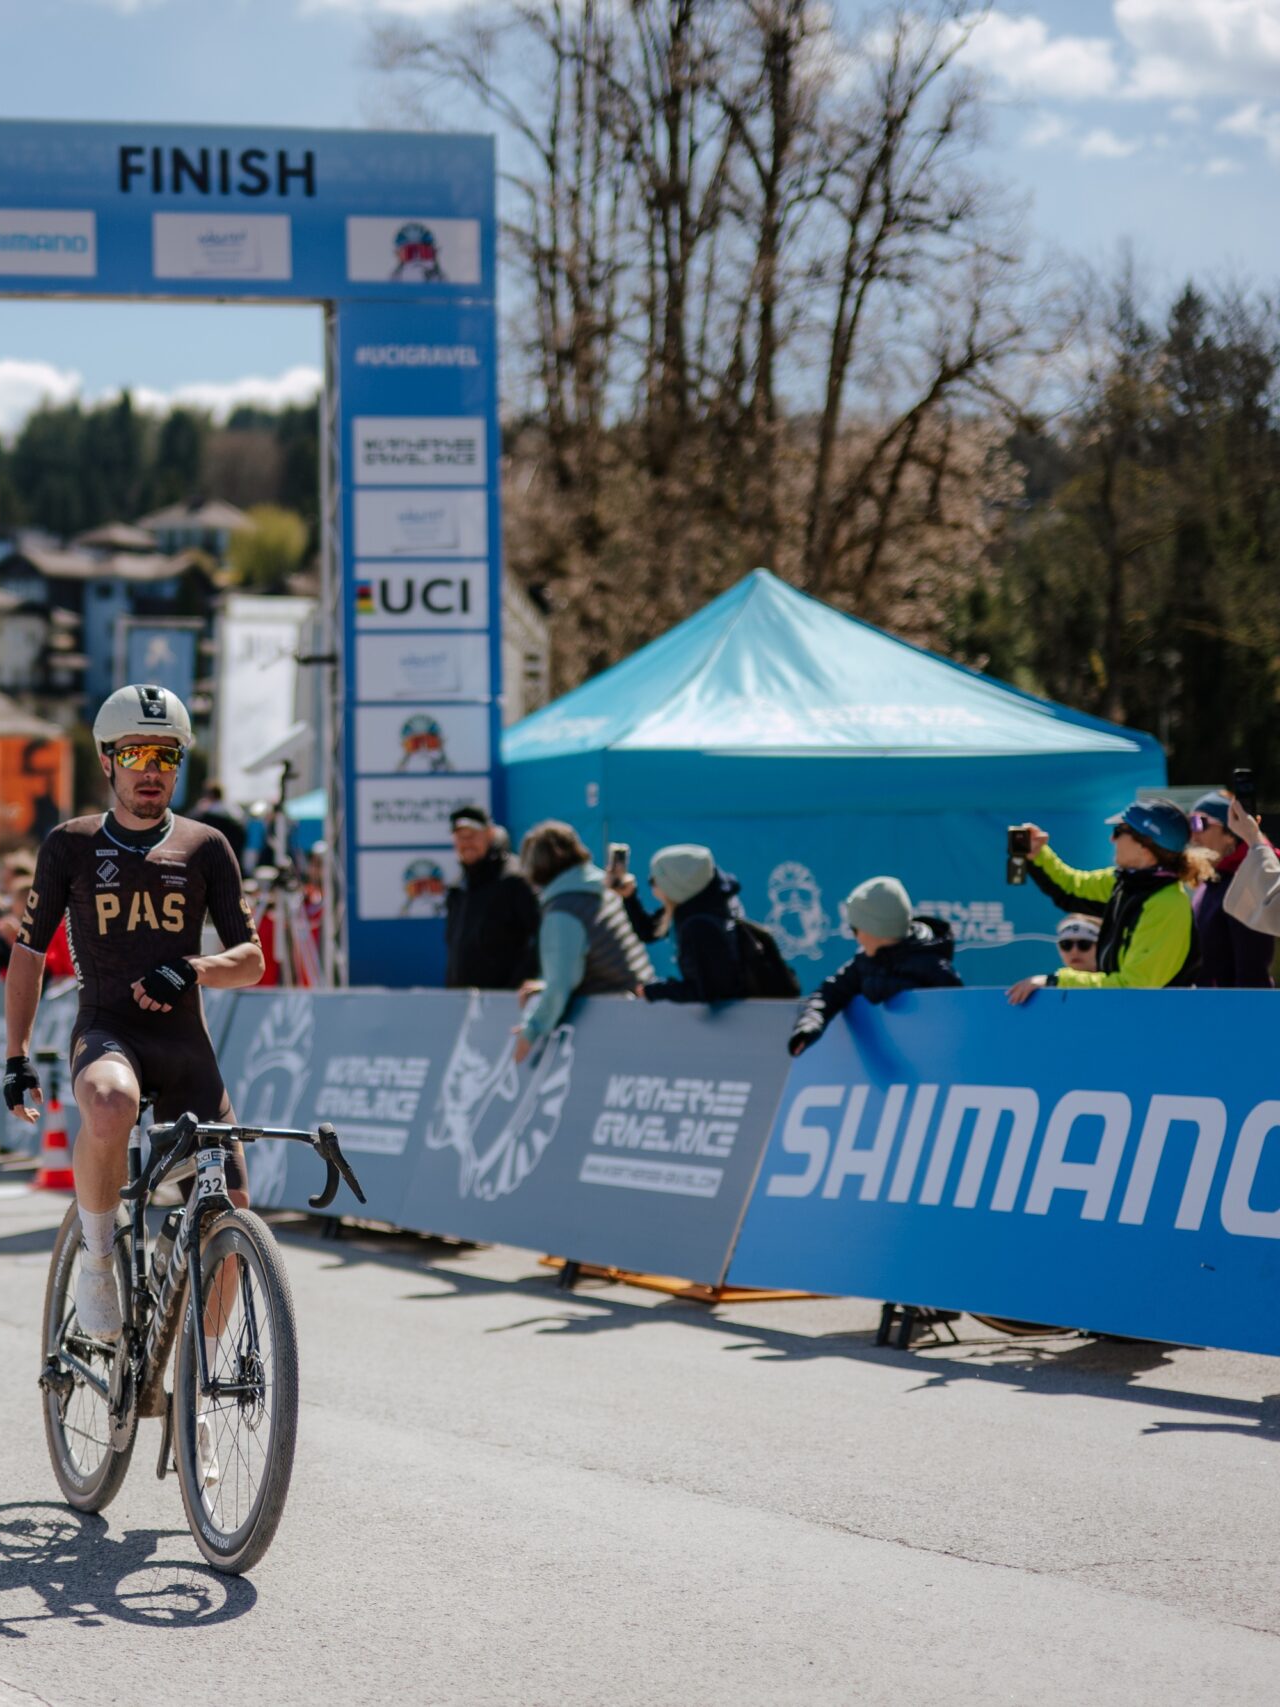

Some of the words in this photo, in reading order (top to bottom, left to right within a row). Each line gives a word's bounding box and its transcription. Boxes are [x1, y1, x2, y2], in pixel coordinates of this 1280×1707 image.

[120, 145, 317, 197] FINISH
[354, 344, 480, 367] #UCIGRAVEL
[380, 576, 471, 616] UCI
[95, 891, 186, 935] PAS
[673, 1117, 739, 1158] RACE
